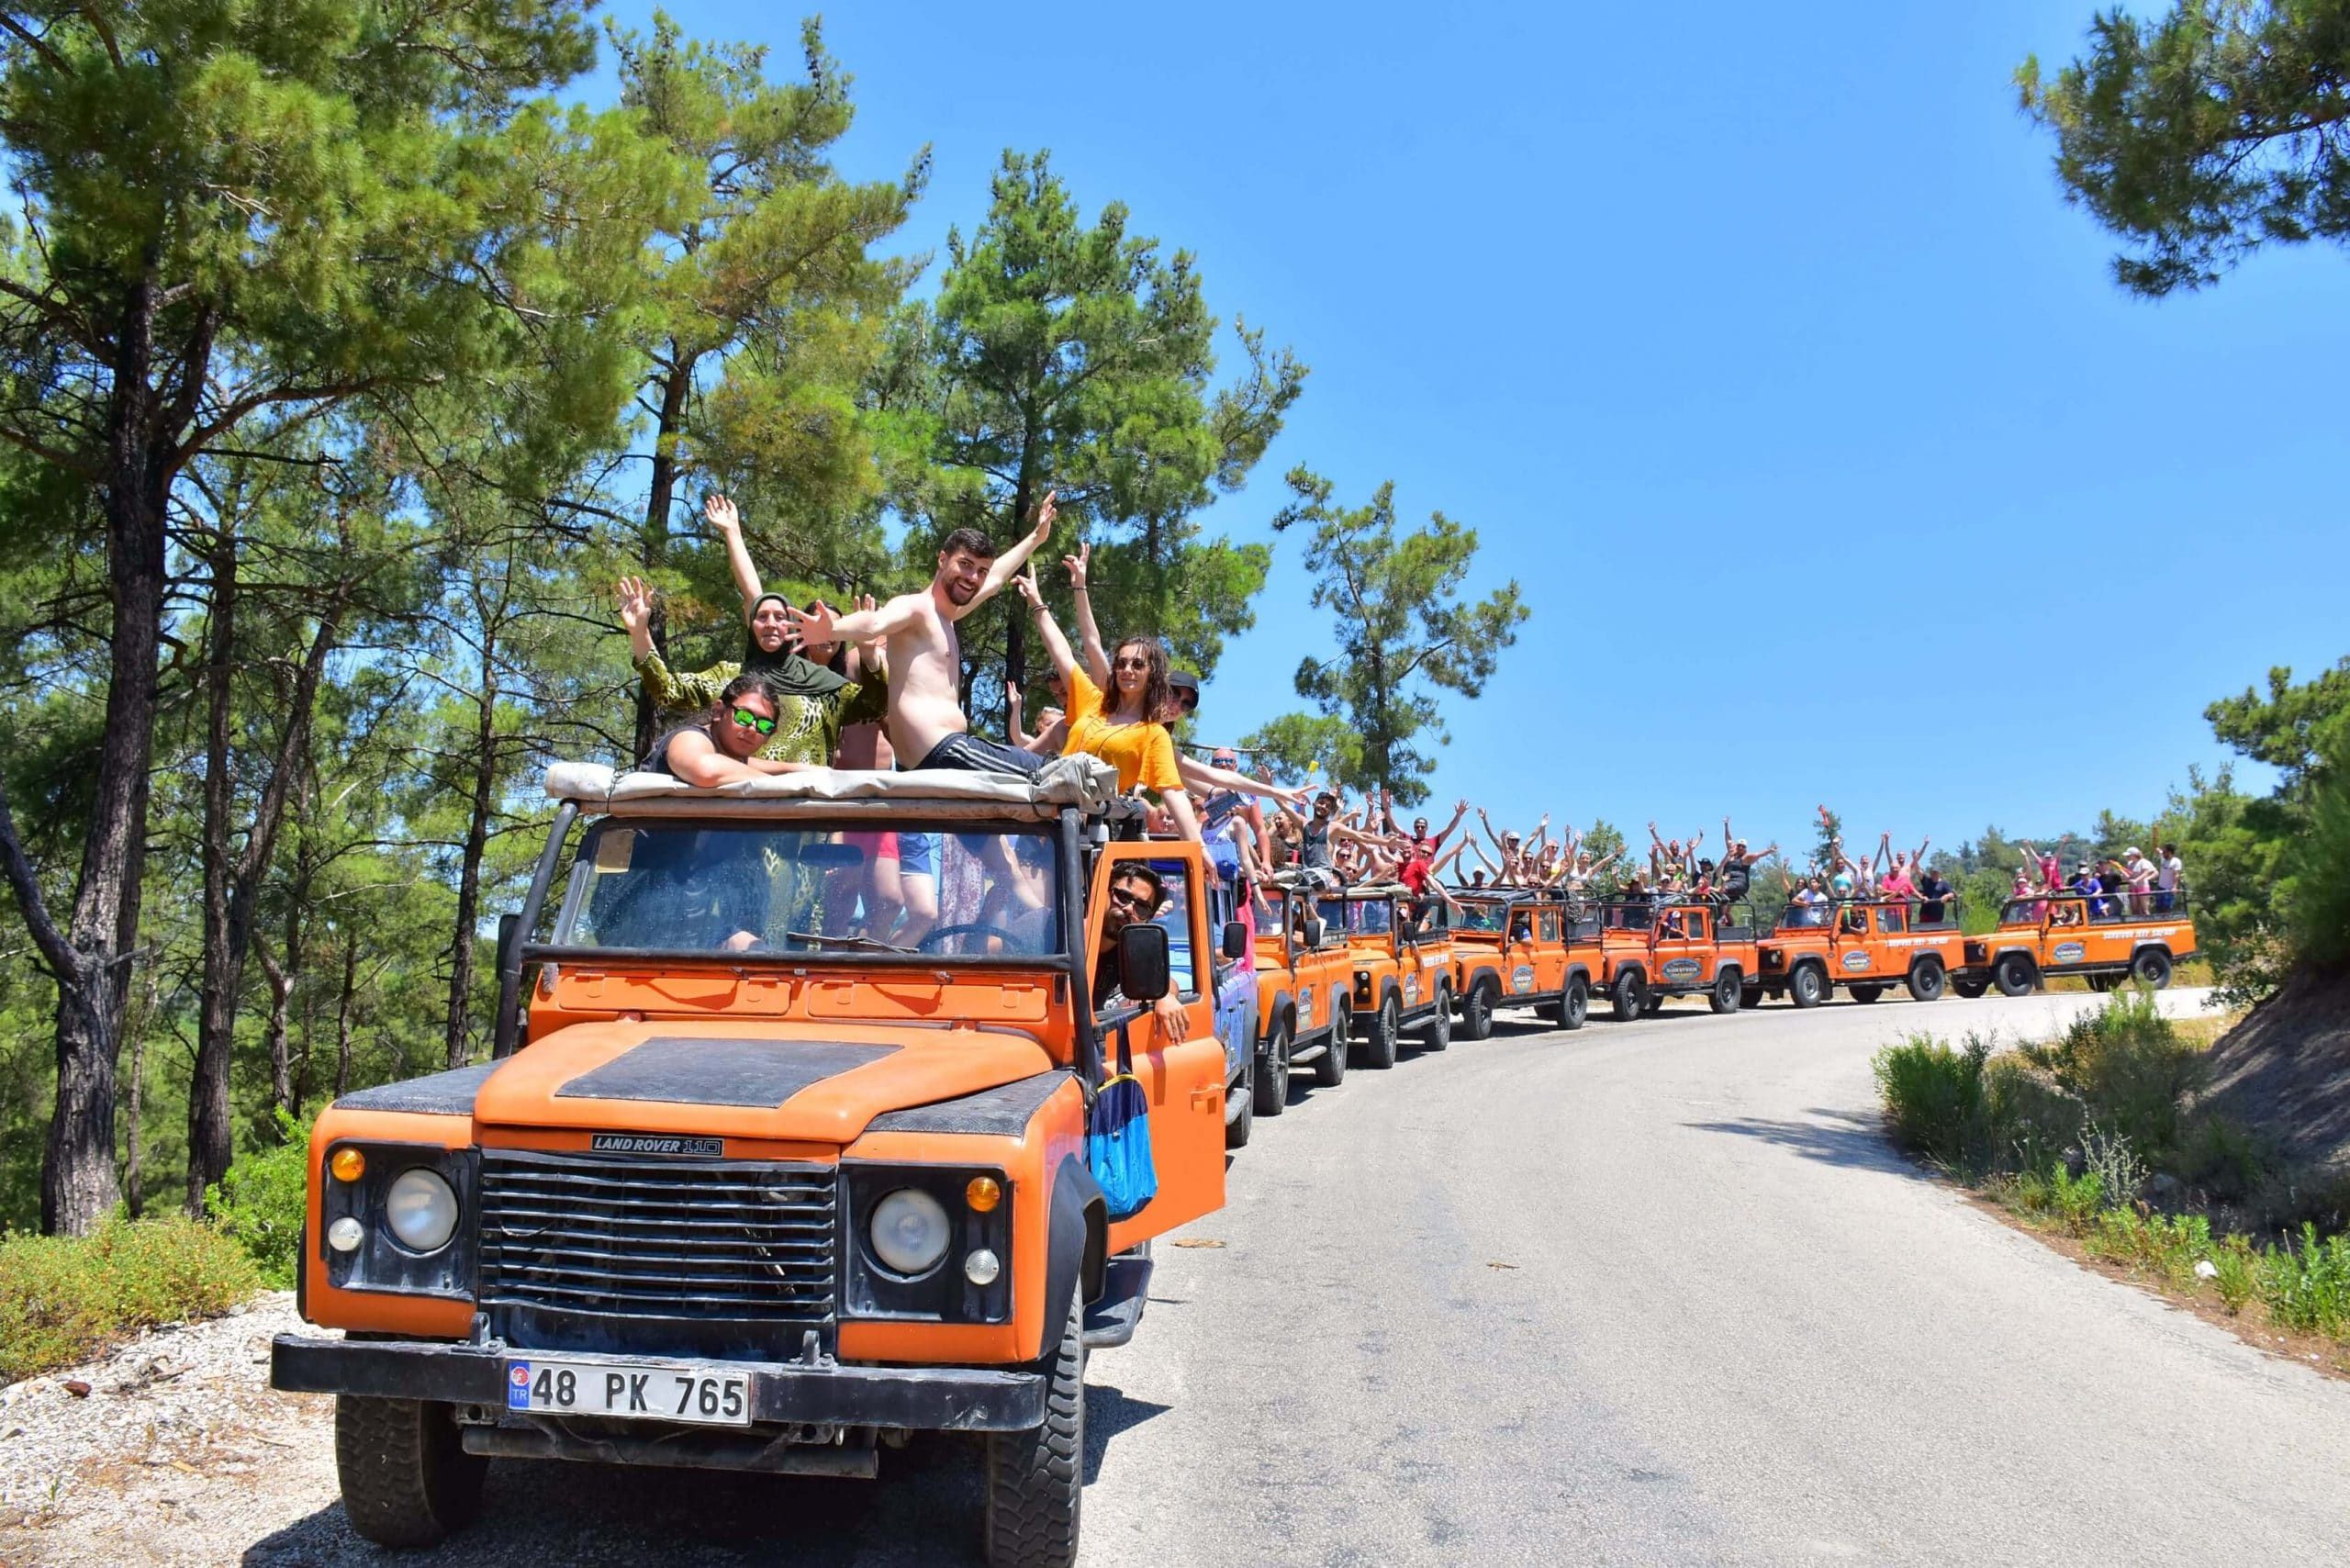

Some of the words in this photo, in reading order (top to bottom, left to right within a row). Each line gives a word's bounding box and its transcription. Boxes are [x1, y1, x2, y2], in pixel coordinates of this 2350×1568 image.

[594, 1137, 635, 1150] LAND
[634, 1138, 680, 1152] ROVER
[682, 1139, 721, 1154] 110
[512, 1388, 528, 1400] TR
[532, 1368, 576, 1406] 48
[606, 1372, 650, 1411] PK
[675, 1376, 744, 1417] 765
